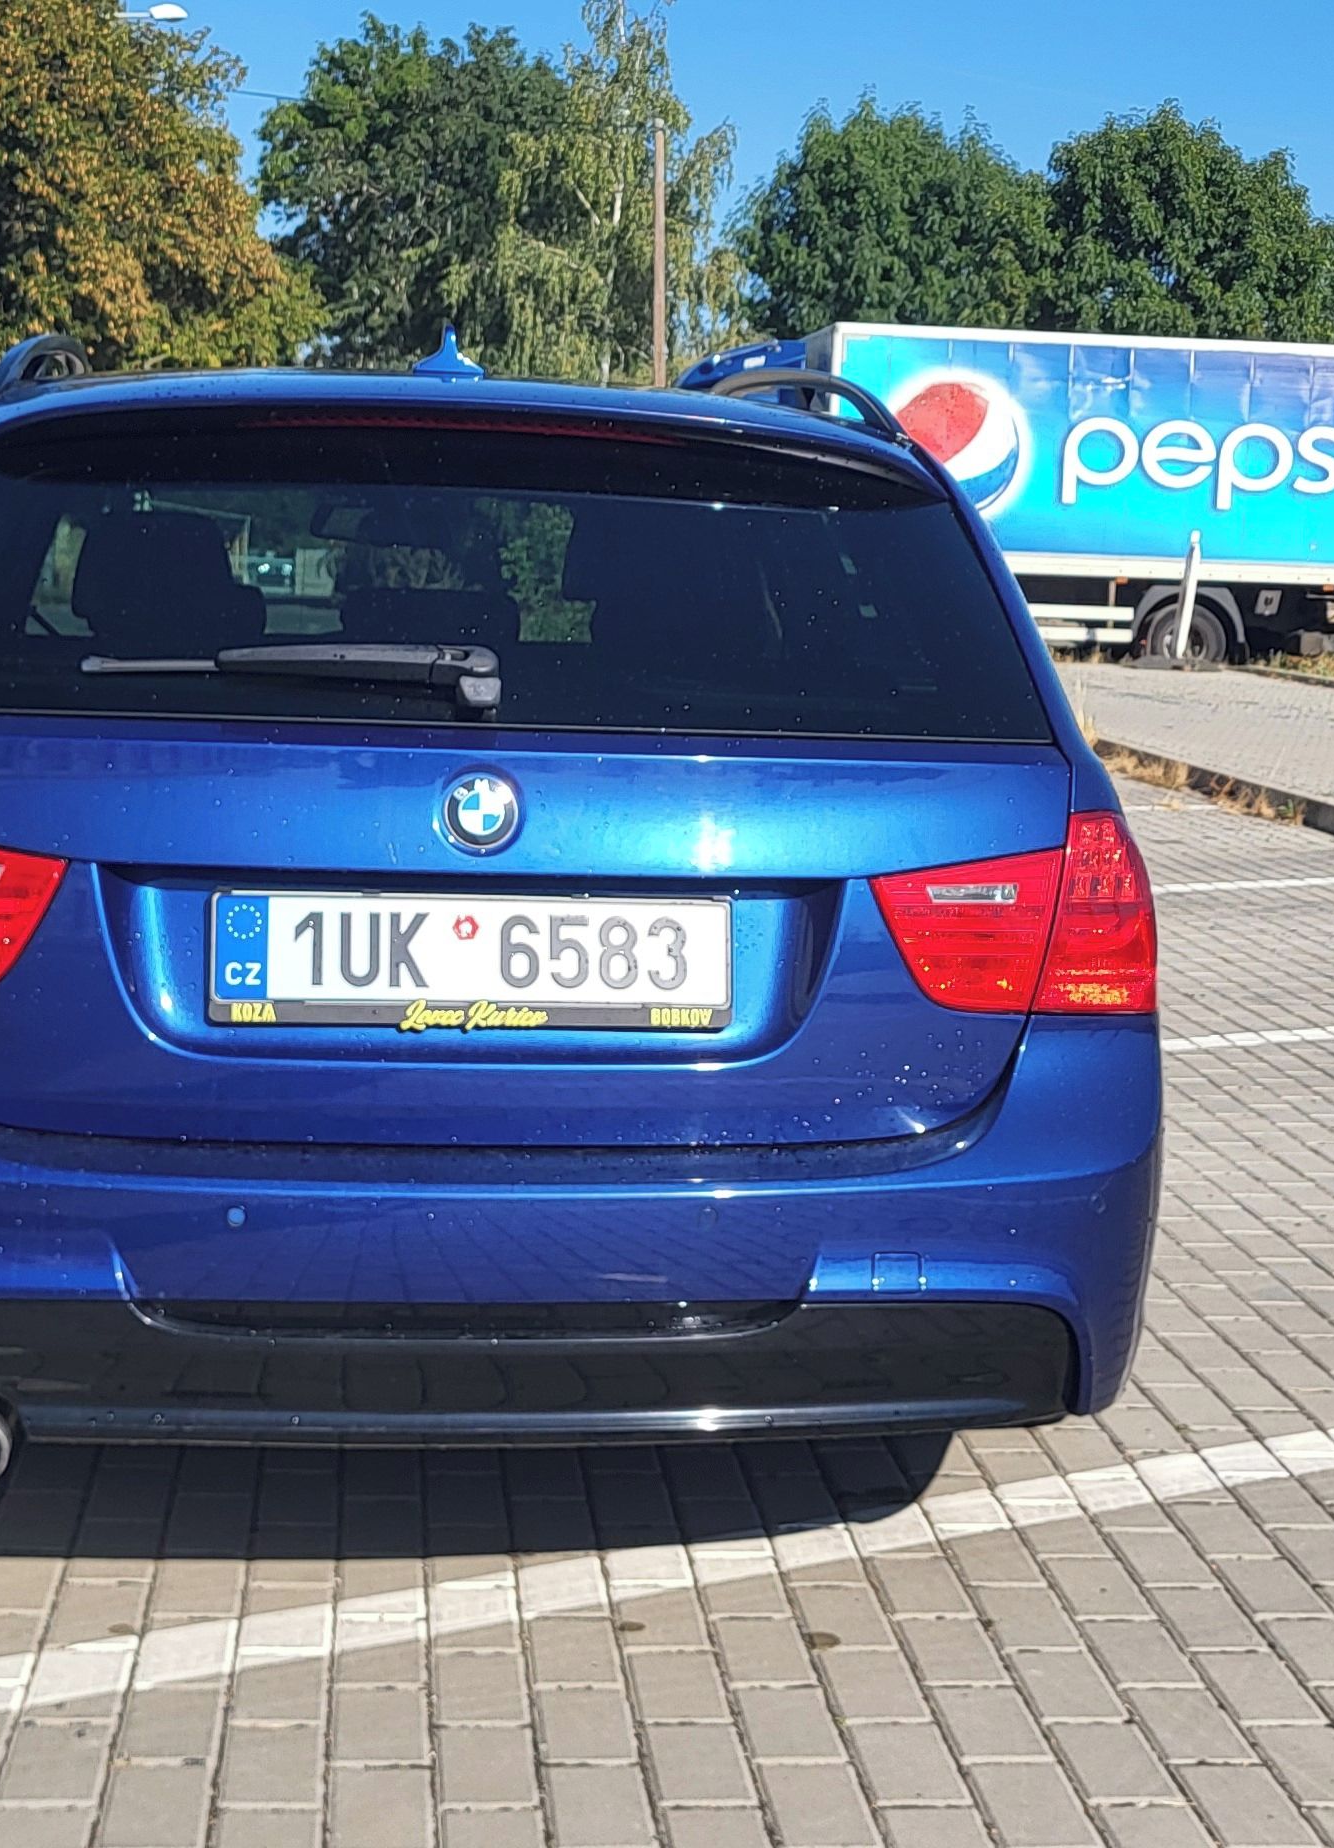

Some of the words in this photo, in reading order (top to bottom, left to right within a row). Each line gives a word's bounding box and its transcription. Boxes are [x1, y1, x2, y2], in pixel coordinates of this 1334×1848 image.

[294, 911, 430, 988] 1UK
[500, 914, 688, 990] 6583
[224, 961, 262, 986] CZ
[230, 1002, 277, 1023] KOZA
[650, 1007, 713, 1026] BOBKOV
